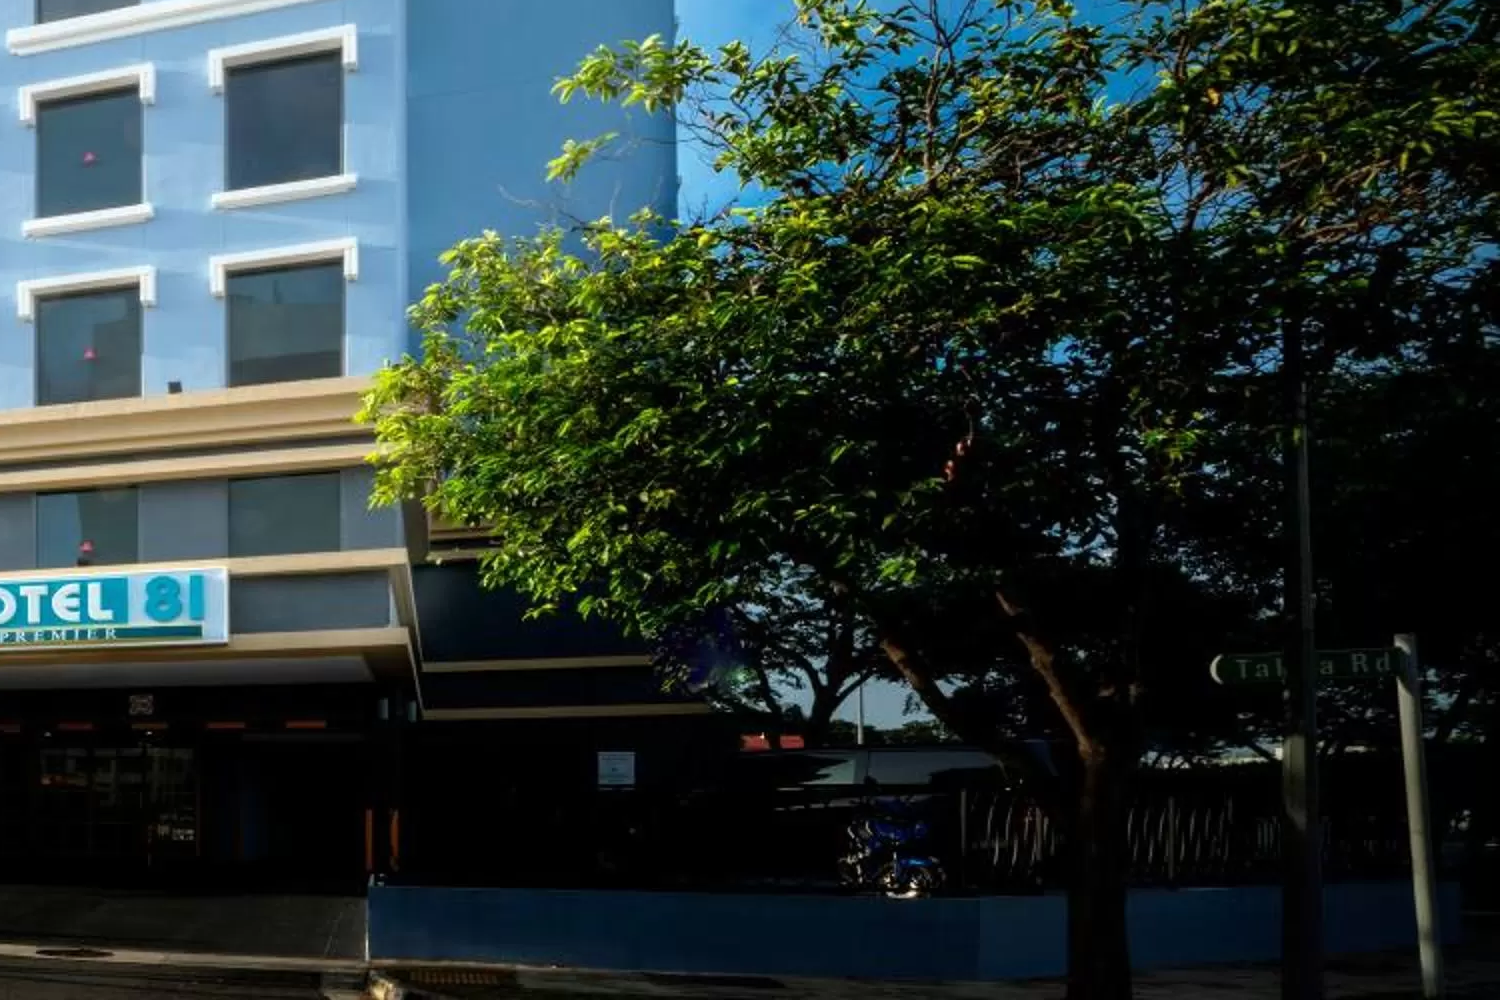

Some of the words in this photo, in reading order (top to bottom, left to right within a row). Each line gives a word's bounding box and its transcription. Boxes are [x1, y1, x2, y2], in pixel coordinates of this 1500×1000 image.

[145, 575, 204, 622] 81
[0, 628, 117, 643] PREMIER
[1234, 658, 1334, 680] Tala
[1351, 652, 1391, 674] Rd
